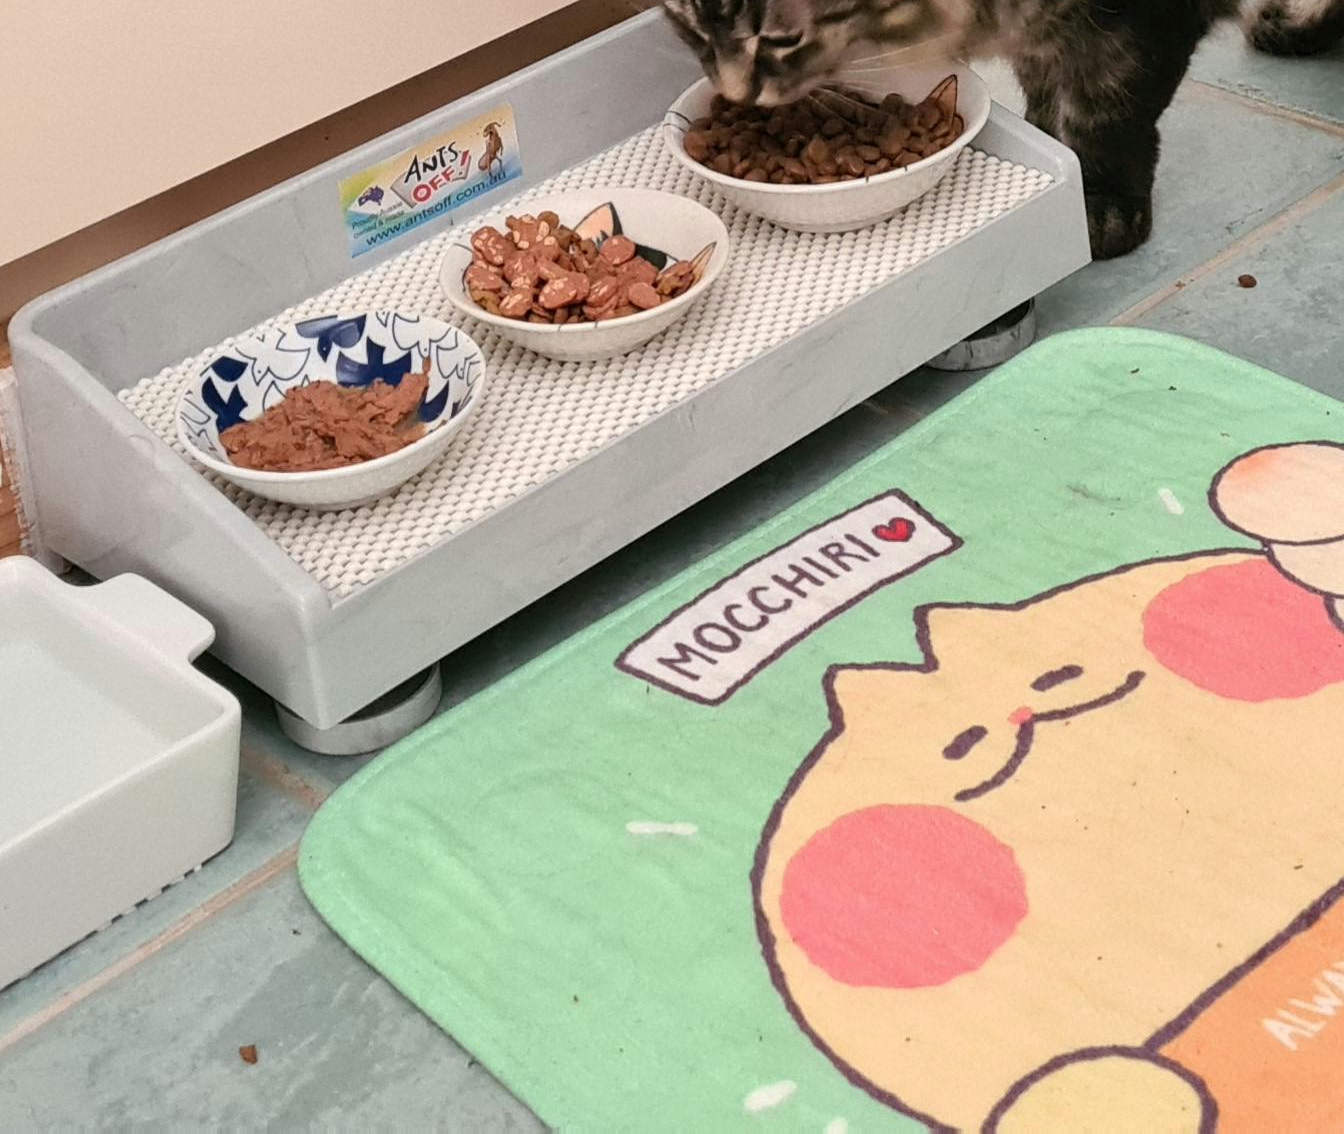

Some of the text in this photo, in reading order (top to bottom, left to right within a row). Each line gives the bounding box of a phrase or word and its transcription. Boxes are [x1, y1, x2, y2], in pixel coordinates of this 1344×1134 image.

[404, 142, 458, 183] ANTS
[412, 149, 471, 203] OFF!
[366, 171, 506, 246] www.antsoff.com.au
[657, 534, 880, 680] MOCCHIRI
